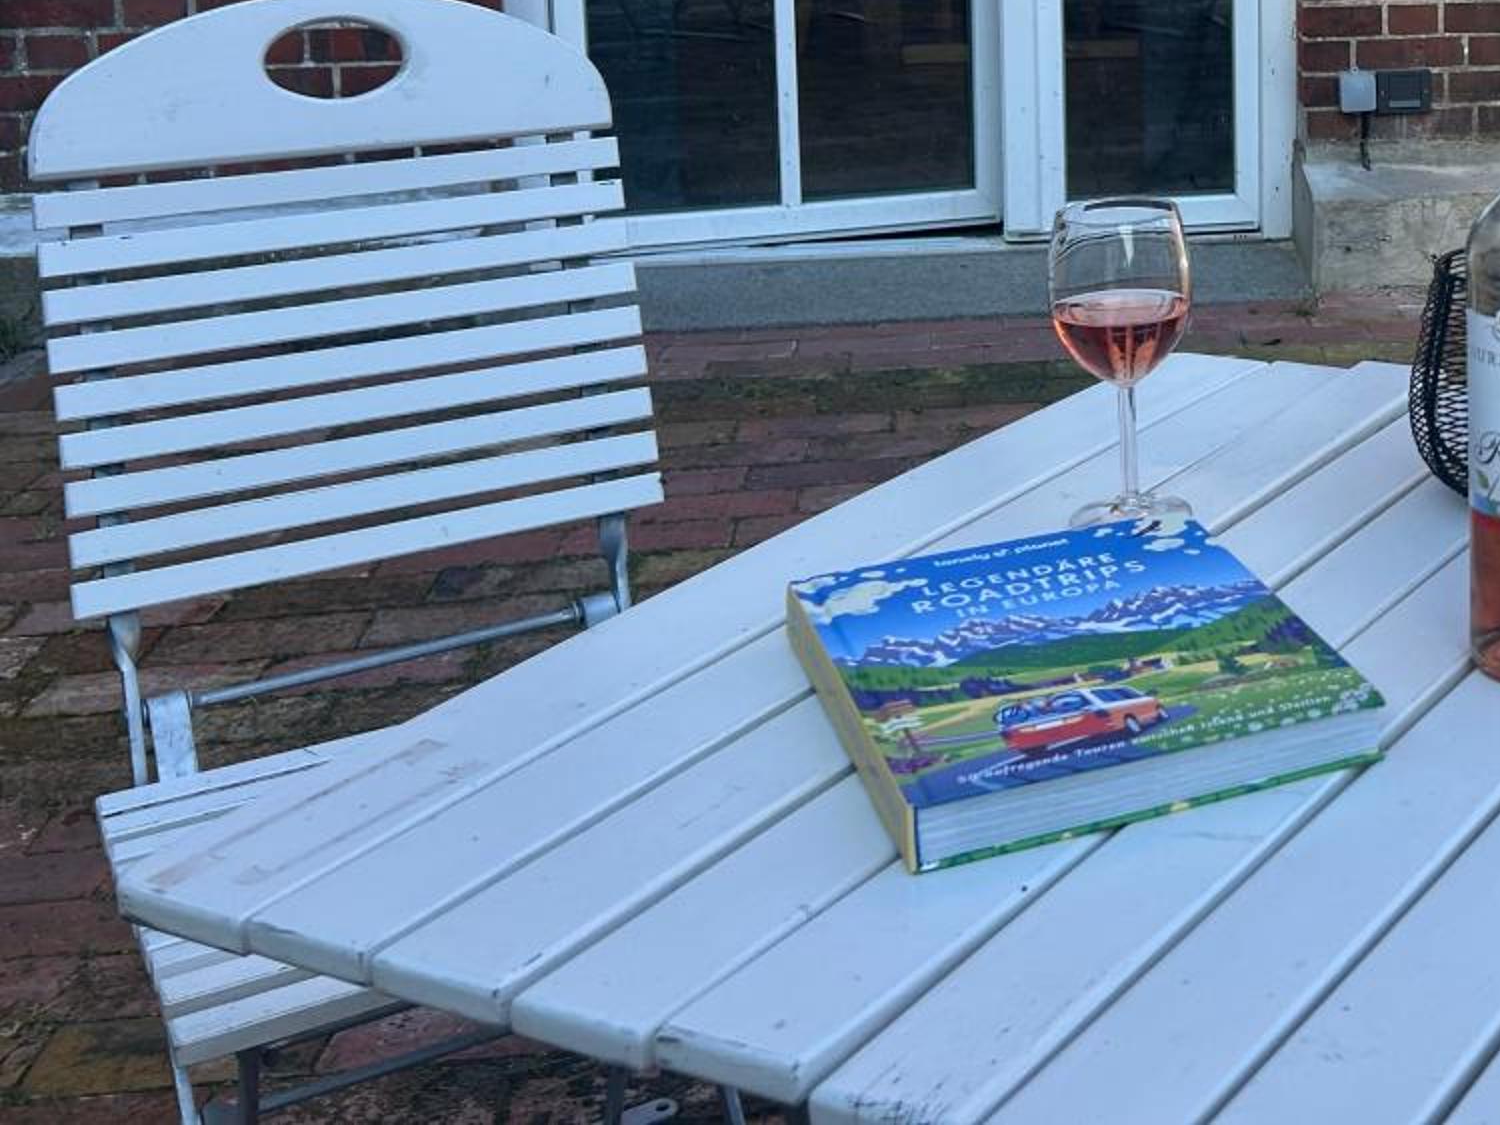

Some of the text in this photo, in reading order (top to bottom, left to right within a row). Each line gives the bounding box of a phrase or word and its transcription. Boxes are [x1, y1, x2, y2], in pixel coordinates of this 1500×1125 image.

[933, 538, 1069, 567] lonely planet
[911, 559, 1146, 614] ROADTRIPS
[923, 552, 1115, 597] LEGENDÄRE
[955, 579, 1120, 618] IN EUROPA
